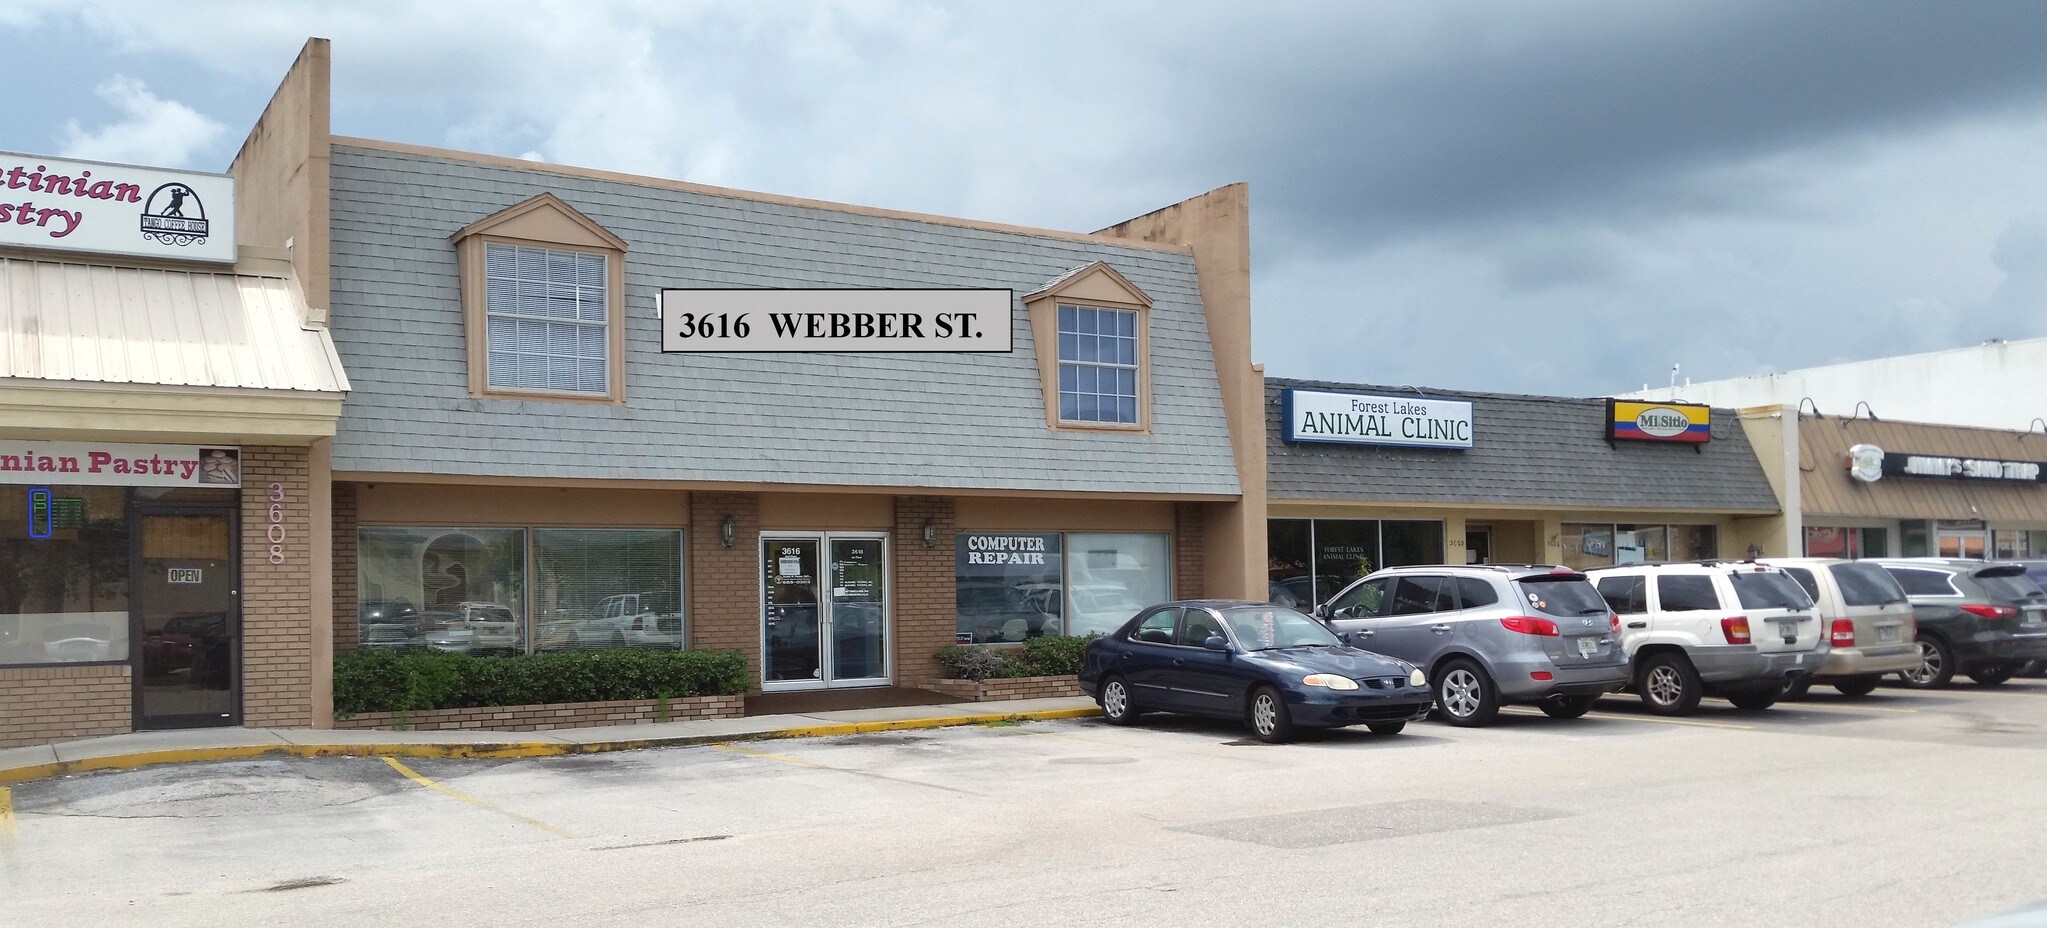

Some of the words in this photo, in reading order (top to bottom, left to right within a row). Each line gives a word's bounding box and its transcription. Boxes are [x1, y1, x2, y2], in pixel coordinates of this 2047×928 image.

[0, 165, 142, 203] tinian
[144, 217, 161, 228] TANGO
[164, 219, 185, 230] COFFEE
[188, 221, 206, 232] HOUSE
[1352, 400, 1389, 414] Forest
[1393, 401, 1427, 416] Lakes
[1301, 411, 1392, 437] ANIMAL
[1401, 417, 1469, 441] CLINIC
[1640, 415, 1657, 427] Mi
[1661, 415, 1688, 428] Sitio
[0, 450, 80, 473] nian
[88, 451, 199, 480] Pastry
[267, 482, 286, 564] 3608
[781, 547, 801, 555] 3616
[968, 535, 1045, 551] COMPUTER
[968, 552, 1045, 565] REPAIR
[170, 569, 200, 582] OPEN
